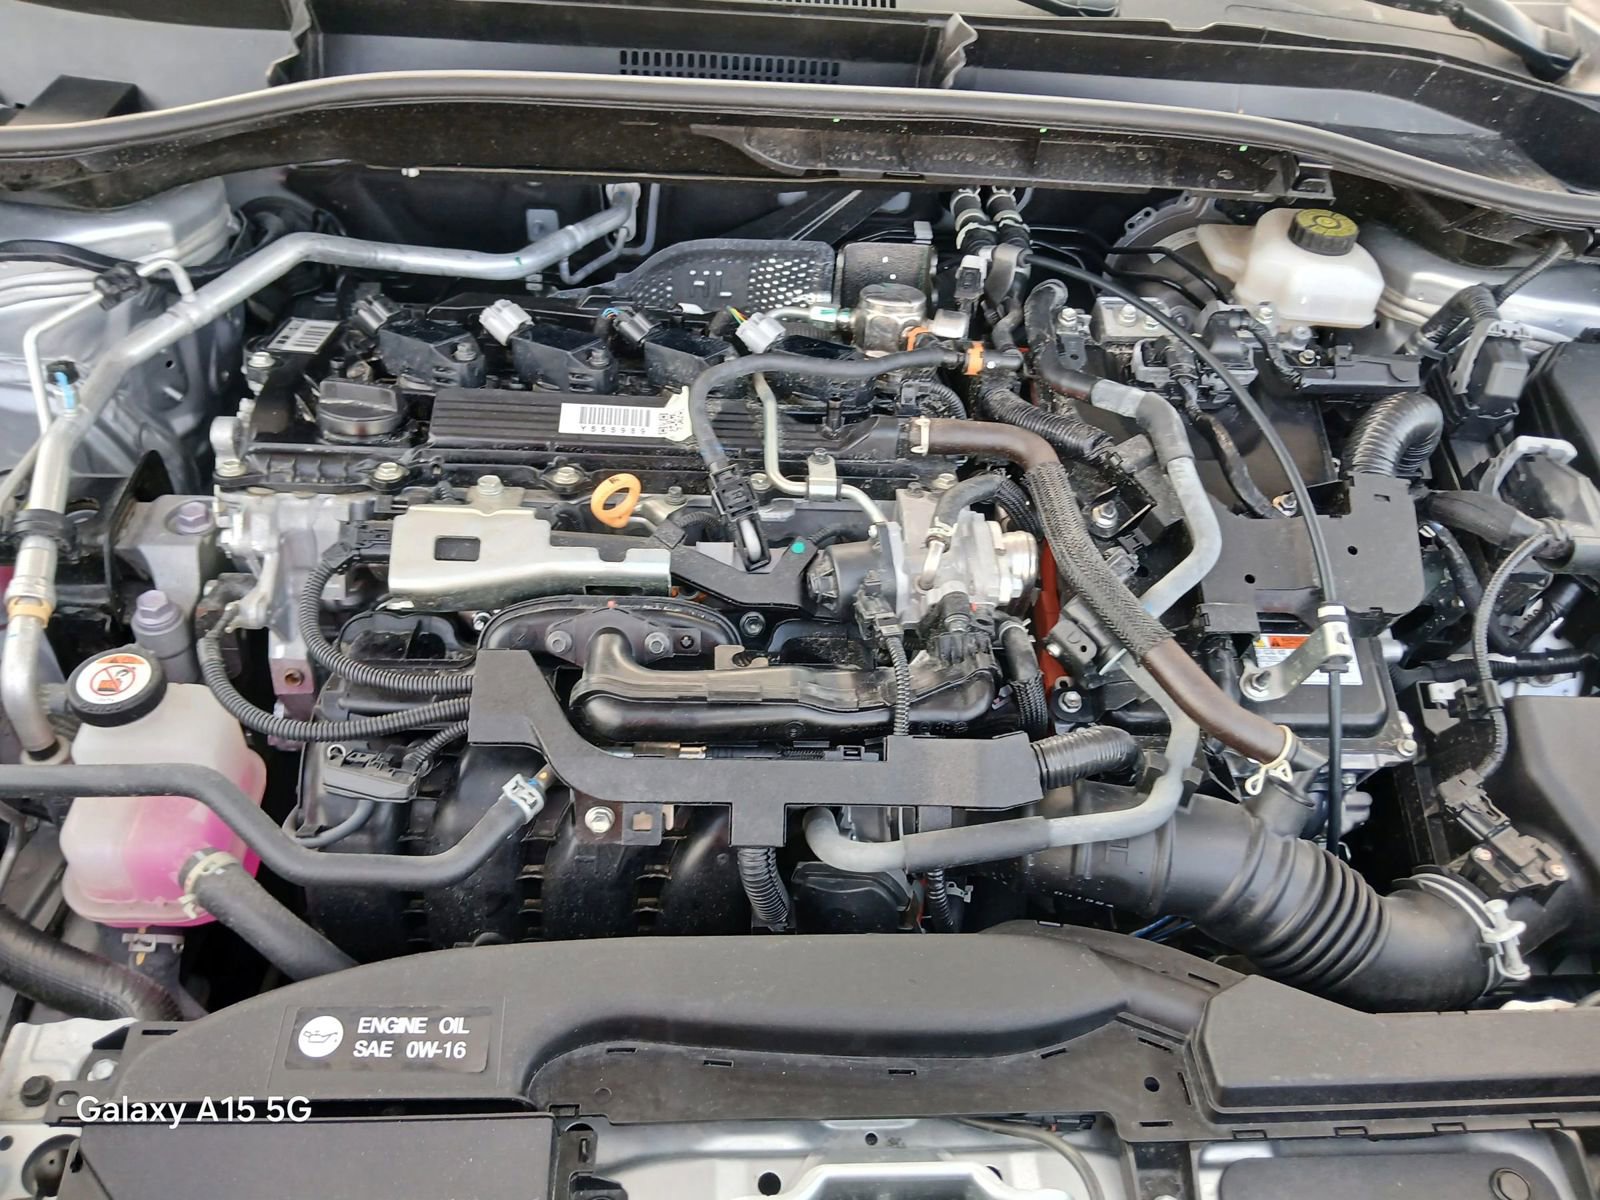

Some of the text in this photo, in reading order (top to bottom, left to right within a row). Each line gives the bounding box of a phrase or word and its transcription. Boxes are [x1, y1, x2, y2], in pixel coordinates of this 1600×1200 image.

[357, 1016, 470, 1034] ENGINE OIL
[353, 1040, 467, 1059] SAE 0W-16
